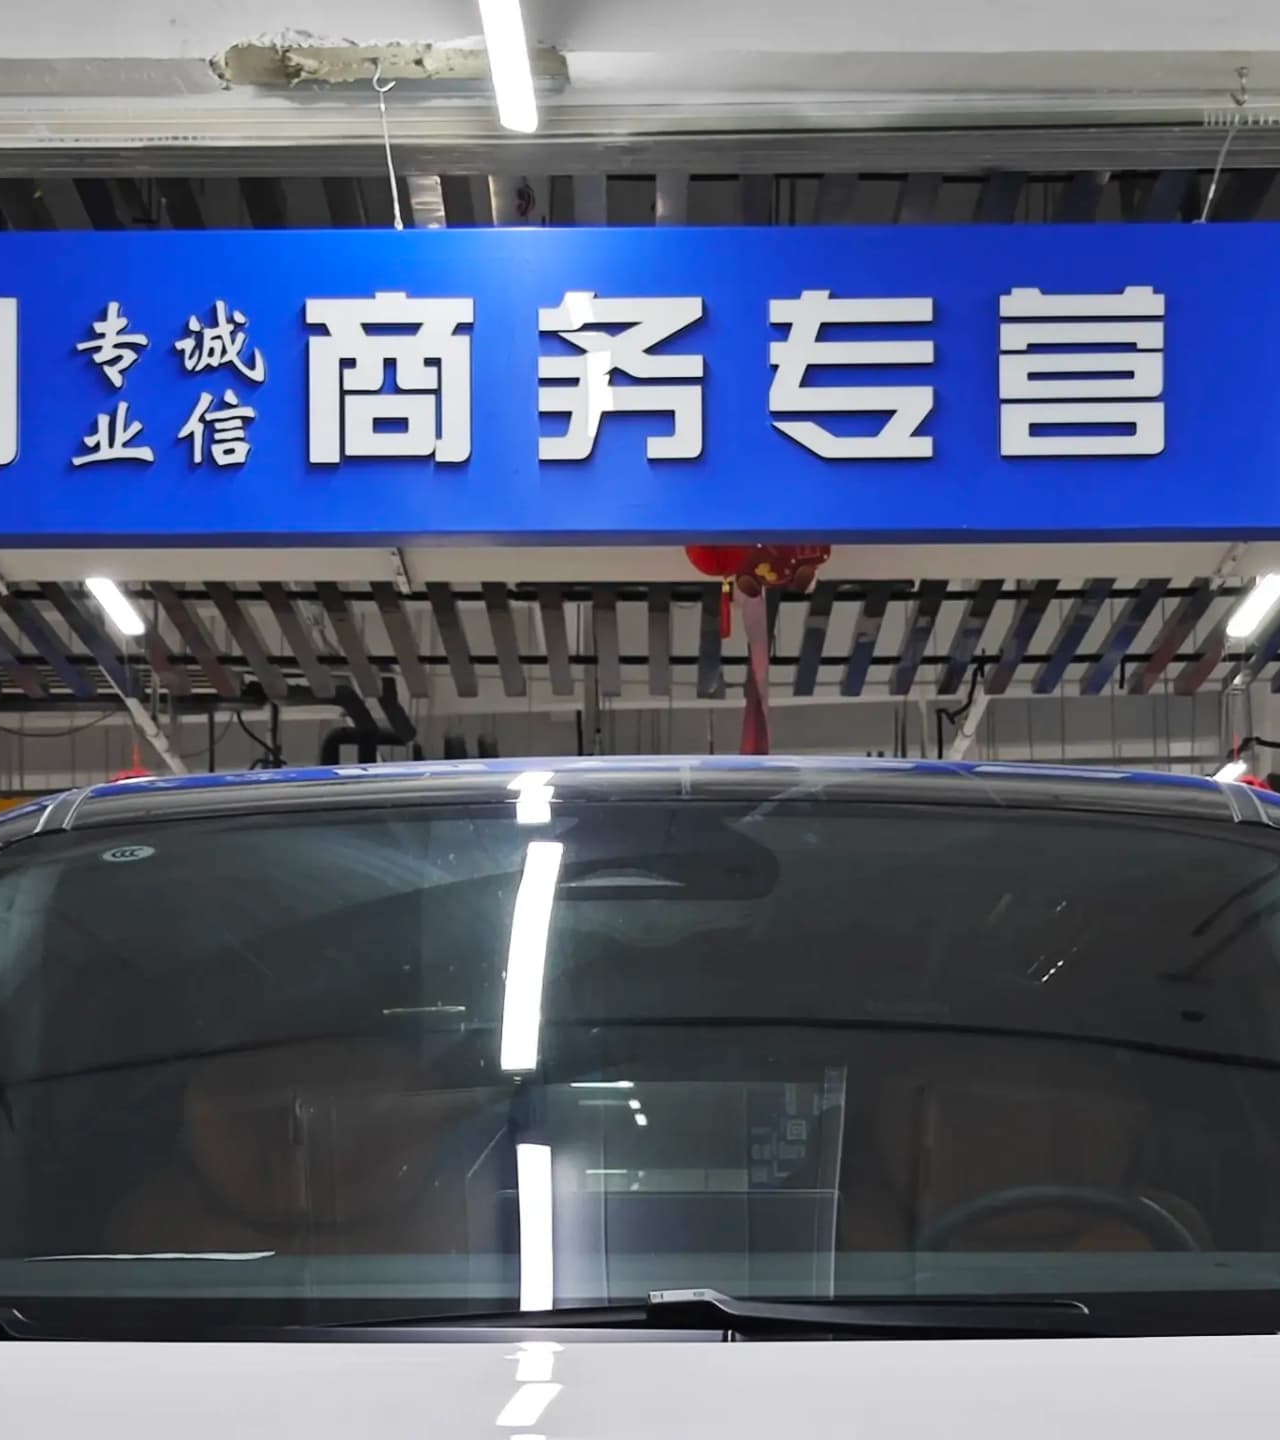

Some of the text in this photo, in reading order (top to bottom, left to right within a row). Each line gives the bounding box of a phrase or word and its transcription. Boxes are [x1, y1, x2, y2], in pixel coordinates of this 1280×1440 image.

[71, 300, 155, 466] 专业
[175, 299, 265, 466] 诚信
[302, 285, 1167, 465] 商务专营
